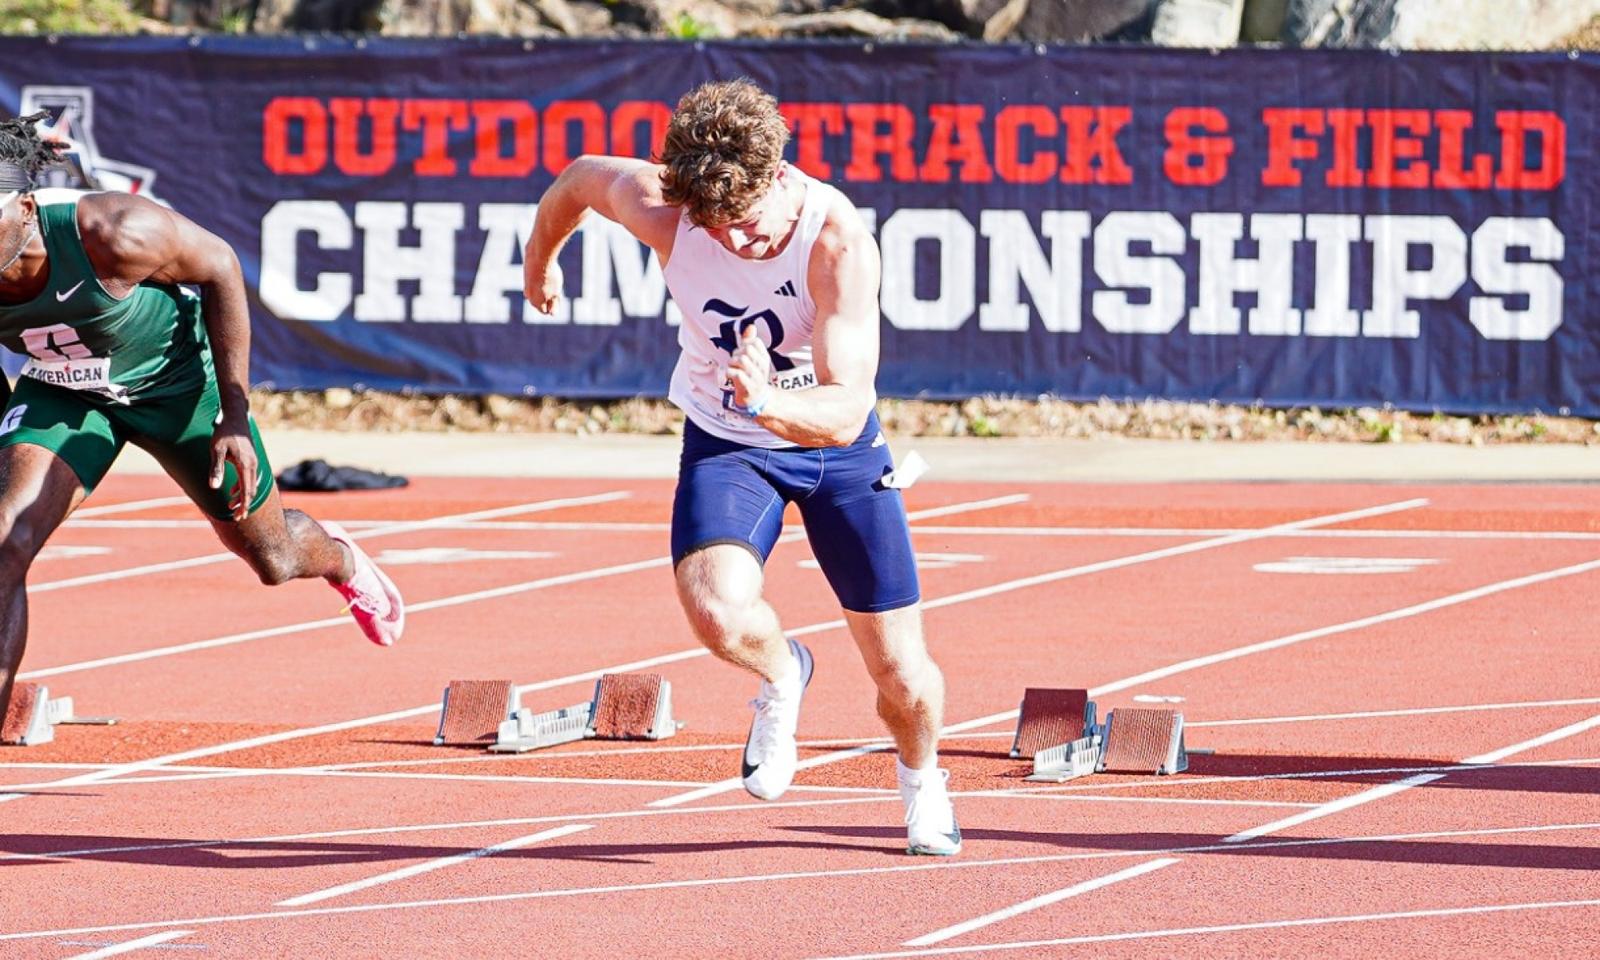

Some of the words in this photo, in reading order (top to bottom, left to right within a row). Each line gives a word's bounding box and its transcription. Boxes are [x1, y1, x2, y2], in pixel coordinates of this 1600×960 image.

[263, 96, 672, 177] OUTDOO
[782, 103, 1131, 184] TRACK
[1163, 106, 1234, 185] &
[1262, 108, 1566, 190] FIELD
[259, 199, 1565, 340] CHAMONSHIPS
